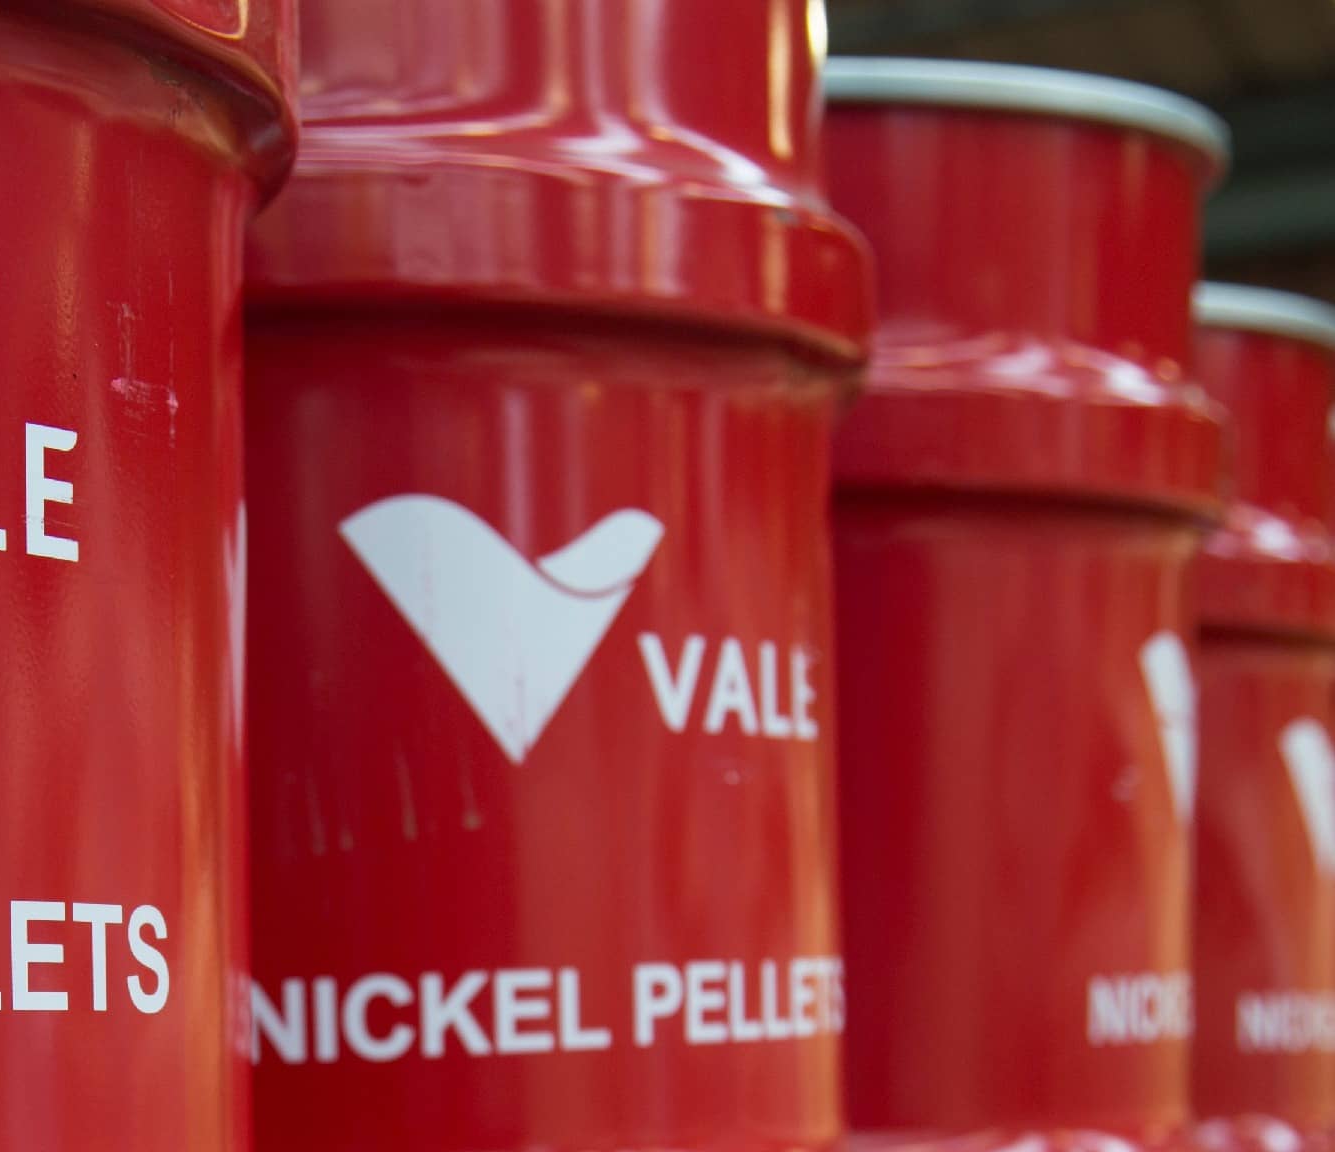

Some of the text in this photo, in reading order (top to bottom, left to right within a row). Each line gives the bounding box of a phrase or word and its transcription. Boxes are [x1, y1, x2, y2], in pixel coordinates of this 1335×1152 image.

[637, 631, 819, 742] VALE
[249, 956, 846, 1064] NICKEL PELLETS
